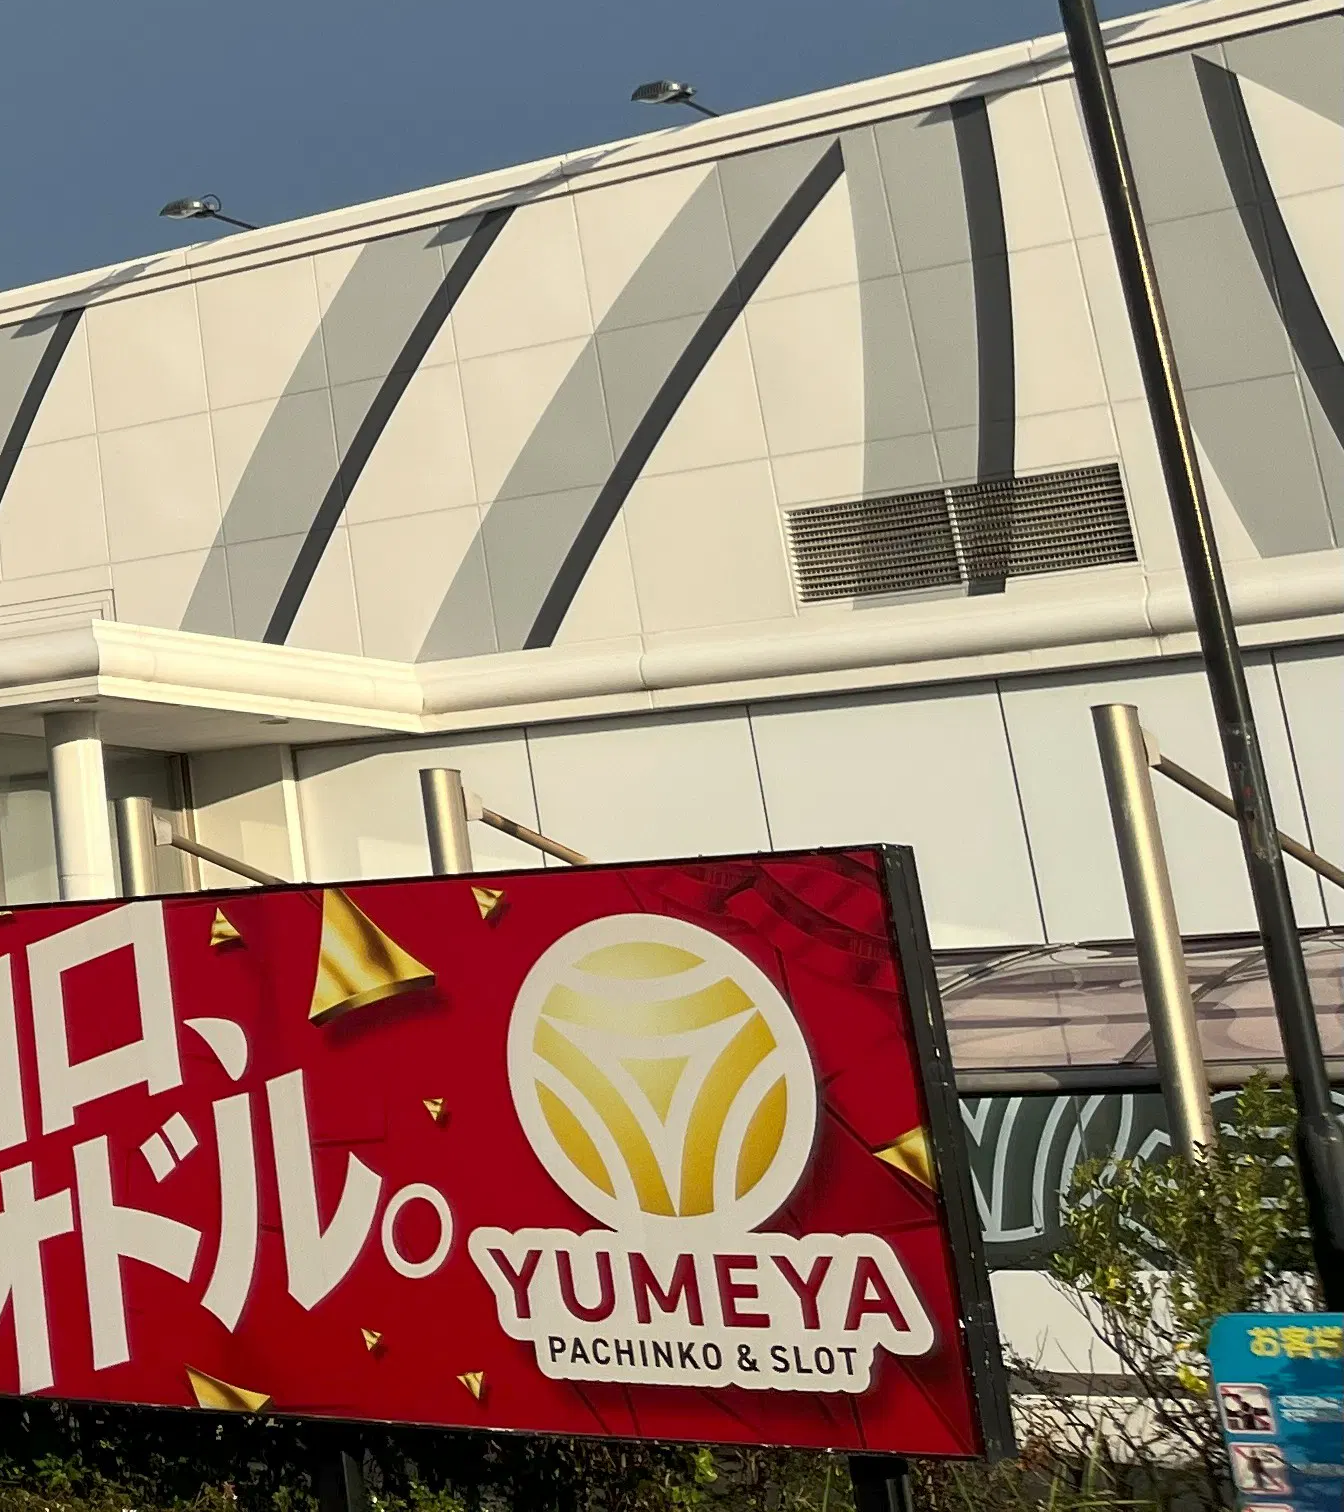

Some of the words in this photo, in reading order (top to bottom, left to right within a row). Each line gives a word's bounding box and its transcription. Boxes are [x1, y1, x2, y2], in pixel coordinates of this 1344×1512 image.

[487, 1248, 910, 1332] YUMEYA
[548, 1336, 723, 1371] PACHINKO
[737, 1346, 760, 1372] &
[771, 1346, 857, 1375] SLOT
